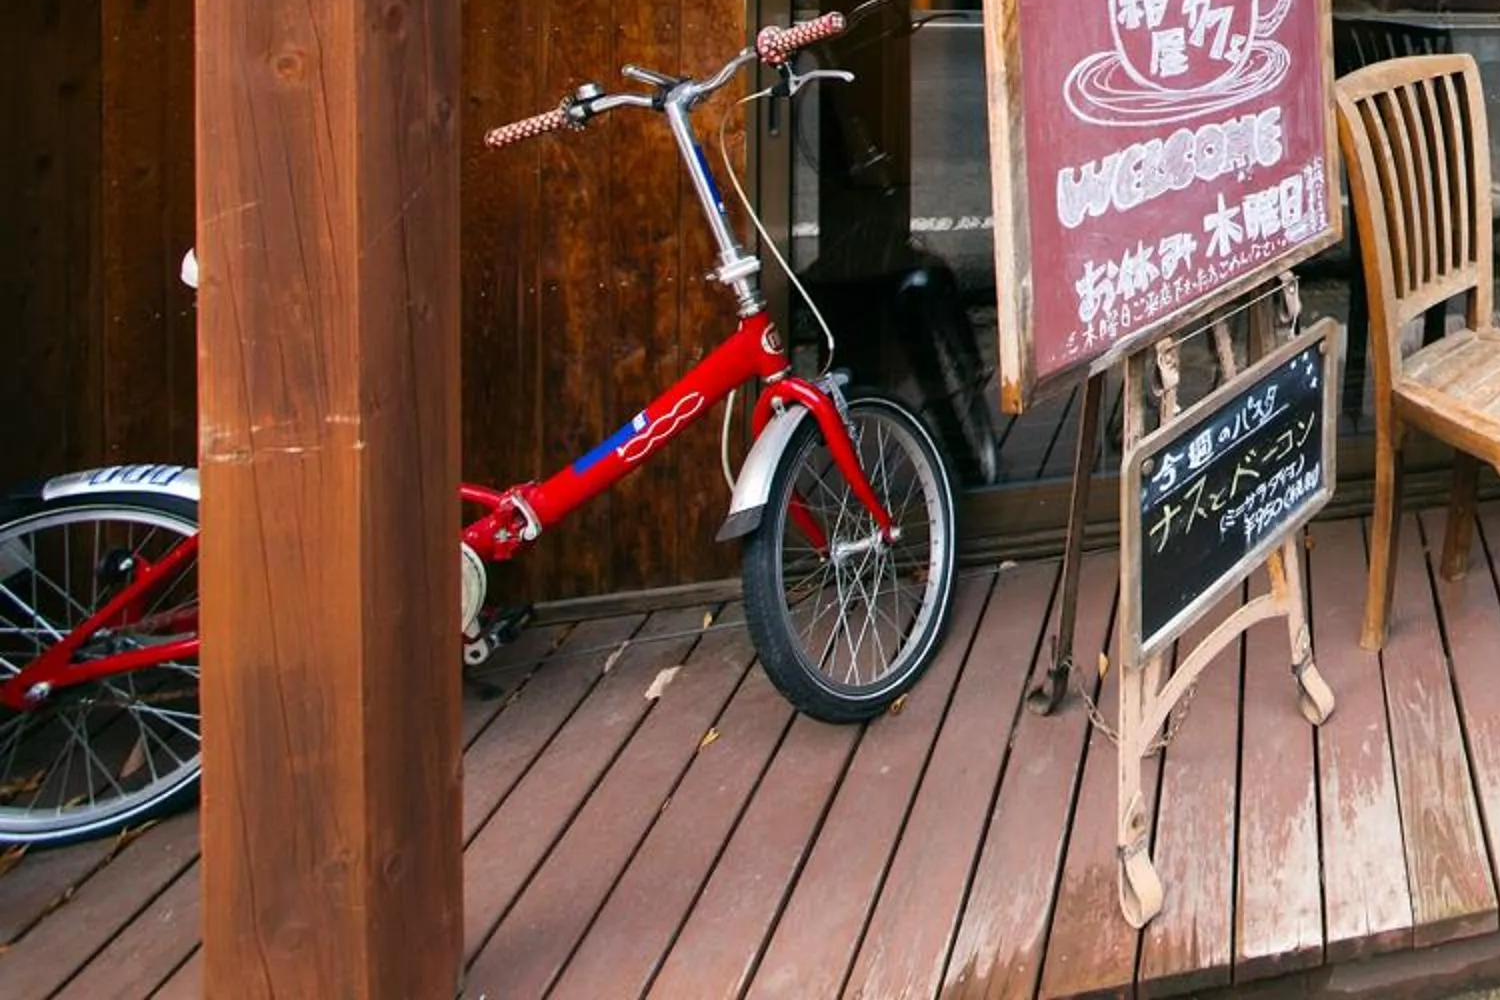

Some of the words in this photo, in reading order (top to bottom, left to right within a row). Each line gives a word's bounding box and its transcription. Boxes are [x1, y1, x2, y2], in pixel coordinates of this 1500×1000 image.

[1056, 106, 1283, 228] WELCOME
[1204, 176, 1304, 257] 木曜日
[1149, 412, 1315, 552] ナスとベーコン
